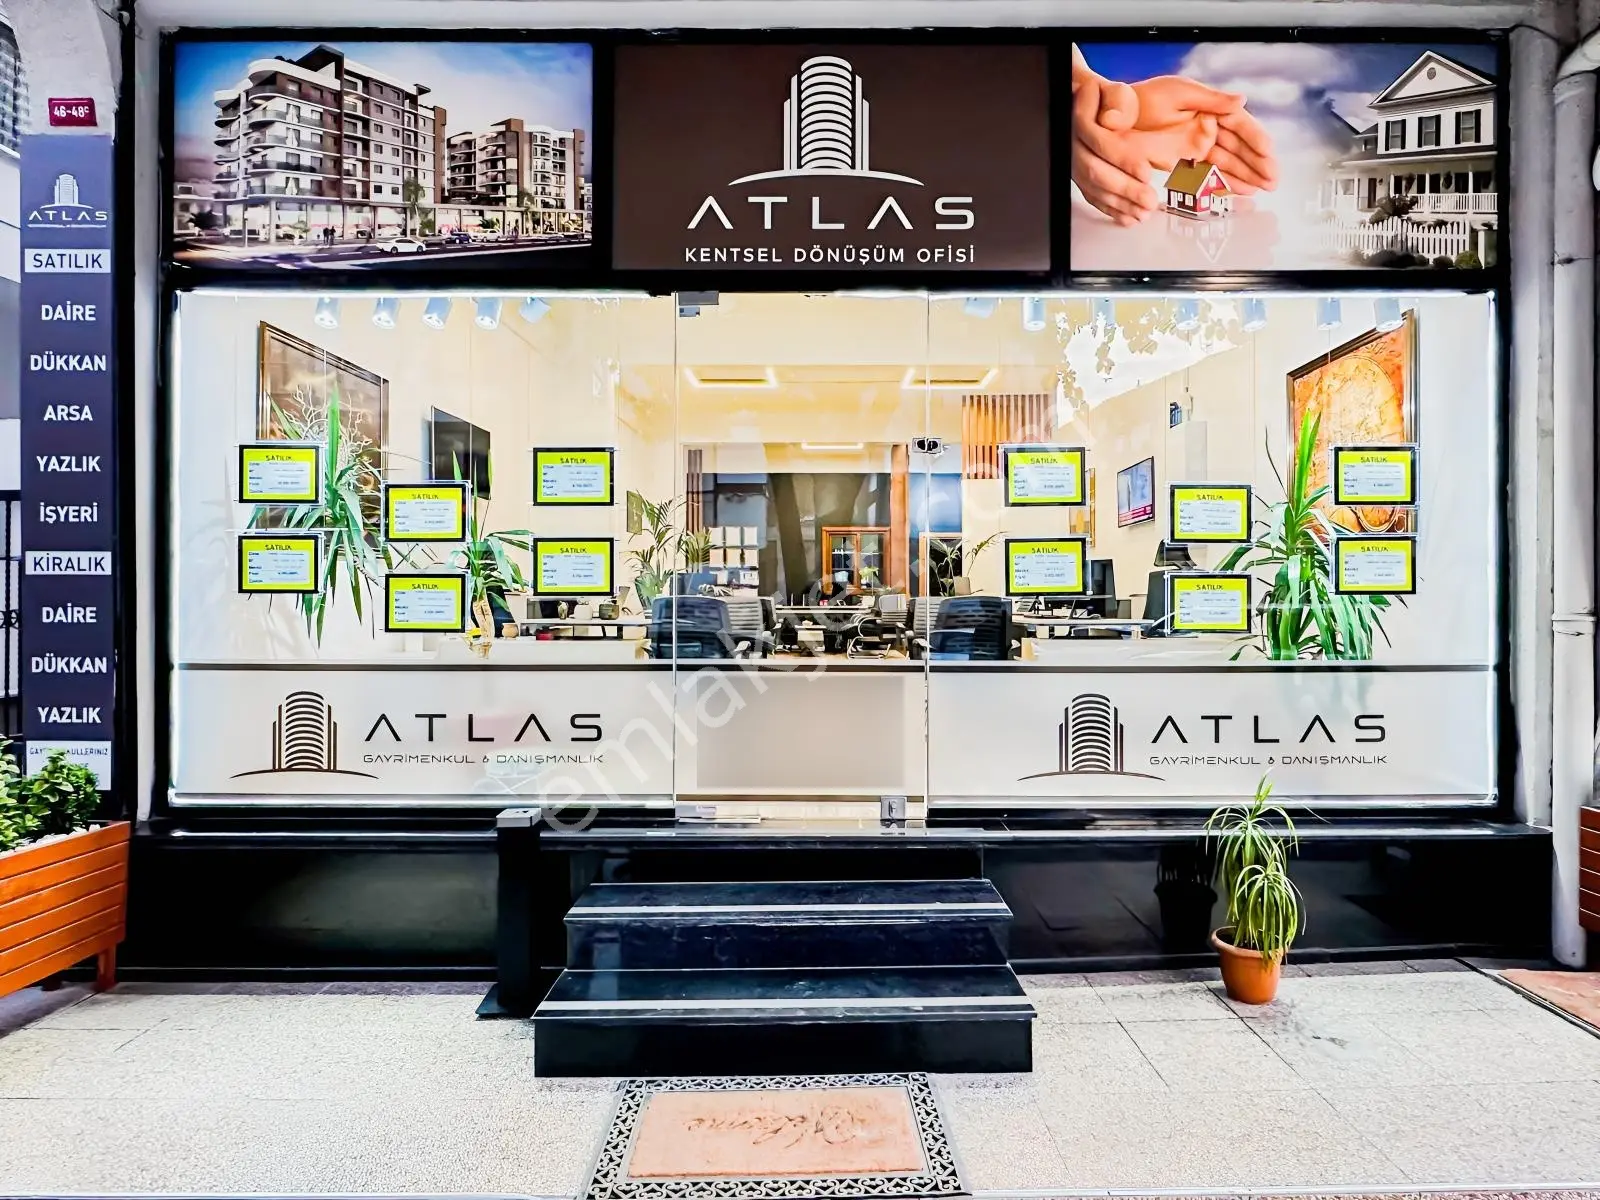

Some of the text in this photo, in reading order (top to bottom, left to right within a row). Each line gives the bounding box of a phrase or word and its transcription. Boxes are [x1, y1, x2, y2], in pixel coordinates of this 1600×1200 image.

[28, 210, 108, 221] ATLAS
[687, 195, 975, 230] ATLAS
[33, 253, 103, 269] SATILIK
[685, 244, 976, 266] KENTSEL DÖNÜŞÜM OFİSİ
[41, 301, 97, 321] DAİRE
[30, 351, 107, 372] DÜKKAN
[43, 404, 93, 422] ARSA
[36, 455, 101, 472] YAZLIK
[39, 502, 98, 524] İŞYERİ
[33, 552, 106, 573] KİRALIK
[41, 603, 97, 624] DAİRE
[31, 652, 108, 674] DÜKKAN
[37, 706, 101, 724] YAZLIK
[364, 713, 603, 743] ATLAS
[1150, 714, 1387, 744] ATLAS
[363, 753, 476, 764] GAYRİMENKUL
[496, 754, 604, 765] DANIŞMANLIK
[1149, 753, 1261, 765] GAYRİMENKUL
[1281, 755, 1388, 767] DANIŞMANLIK
